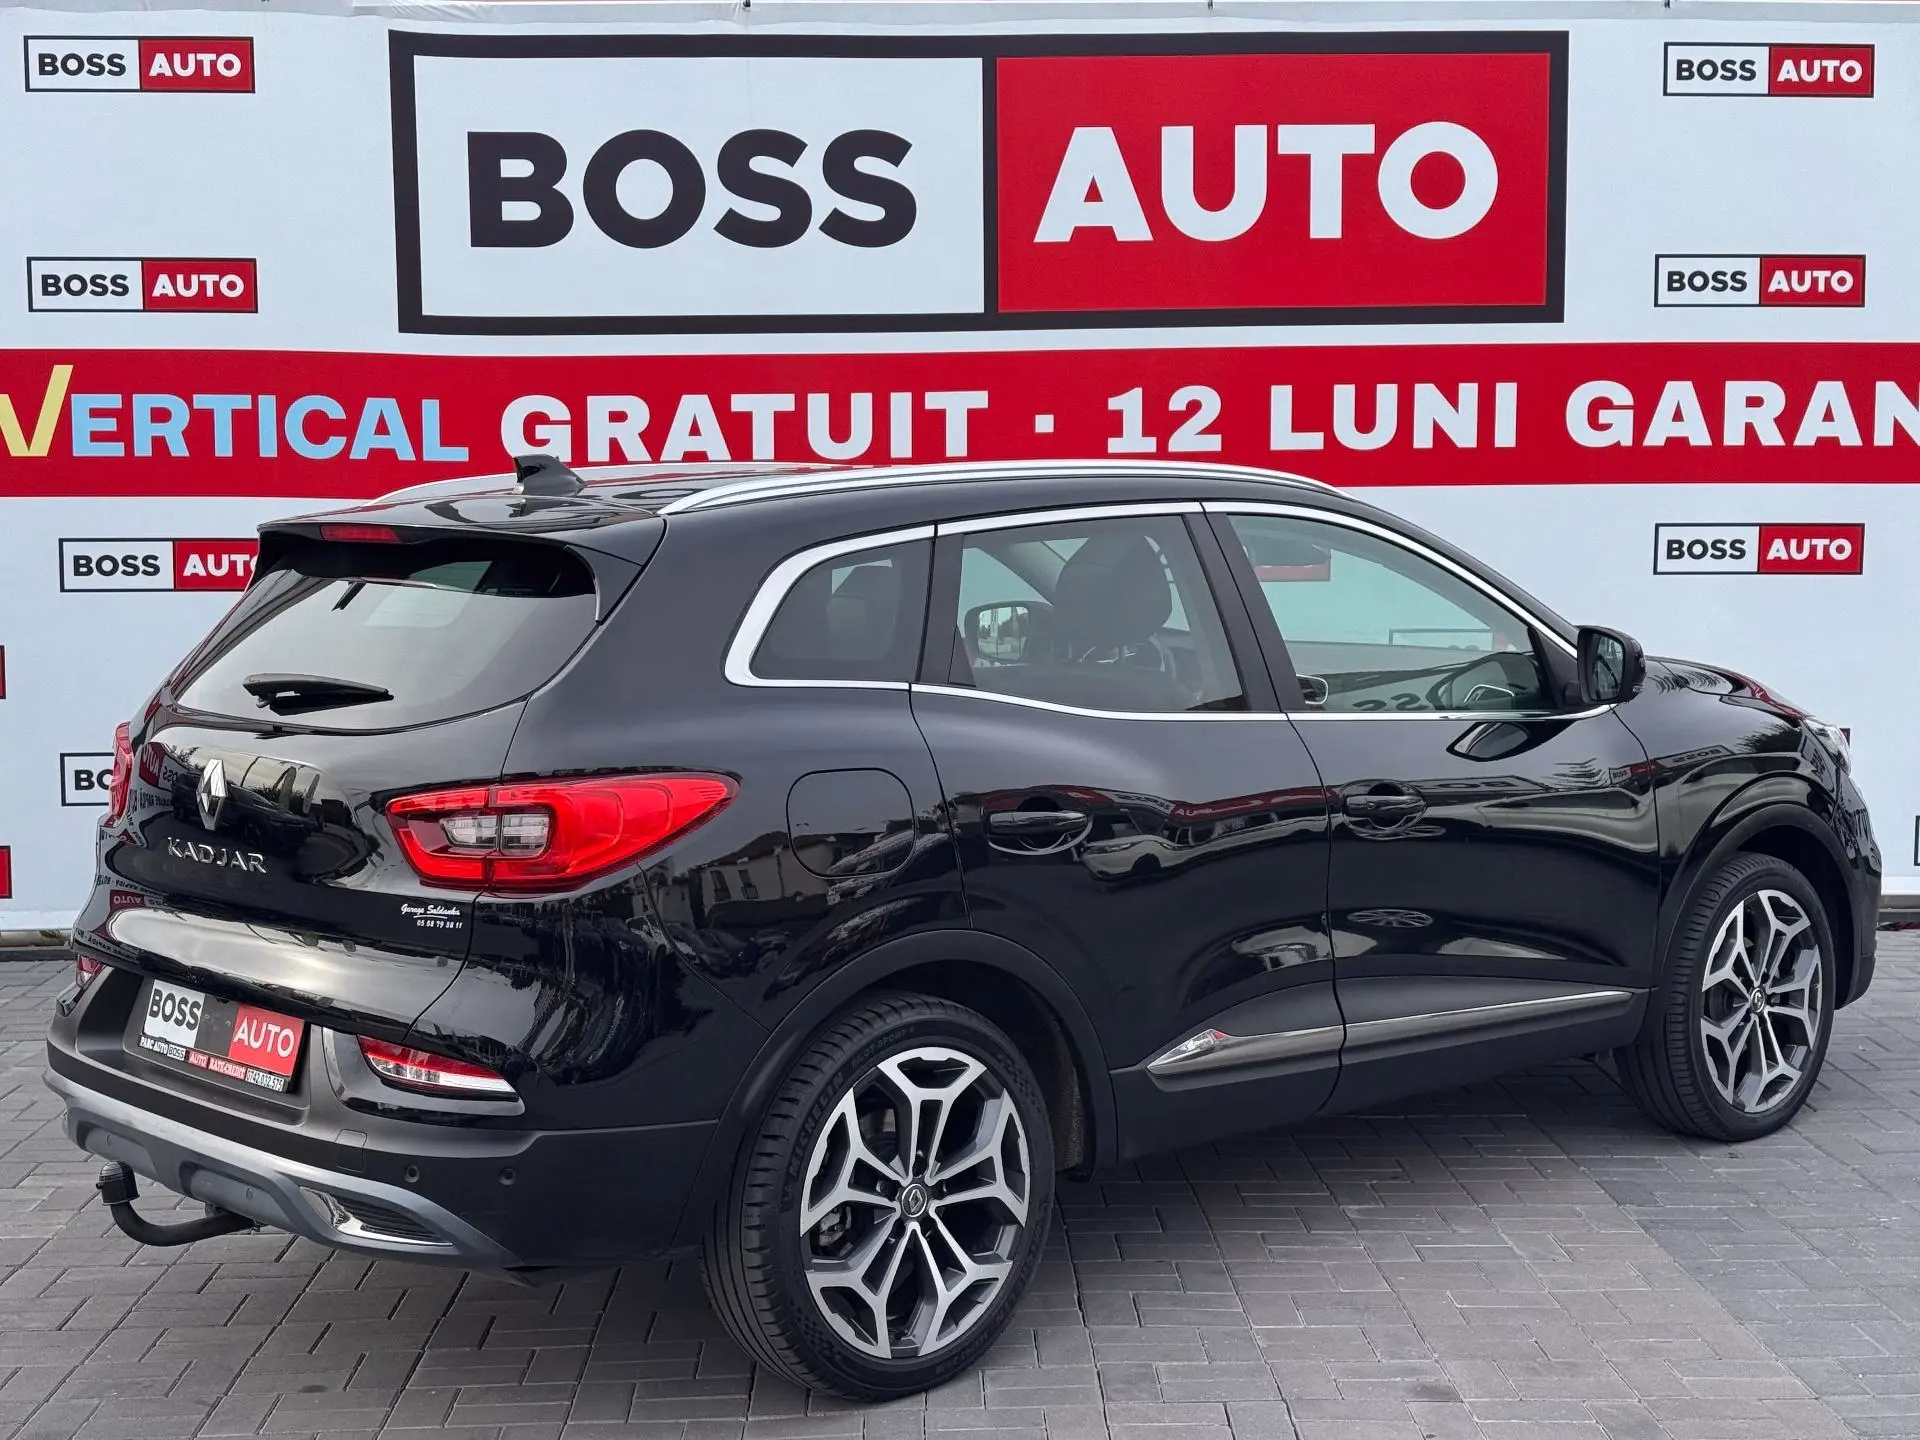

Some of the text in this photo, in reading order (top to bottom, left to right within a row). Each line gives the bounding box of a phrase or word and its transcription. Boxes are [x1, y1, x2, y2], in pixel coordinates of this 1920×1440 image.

[38, 53, 242, 78] BOSS AUTO
[1676, 59, 1863, 83] BOSS AUTO
[467, 121, 1499, 250] BOSS AUTO
[41, 273, 245, 298] BOSS AUTO
[1667, 269, 1854, 293] BOSS AUTO
[0, 364, 470, 462] VERTICAL
[500, 391, 989, 463] GRATUIT
[1106, 385, 1223, 456] 12
[1269, 382, 1518, 451] LUNI
[1666, 538, 1852, 561] BOSS AUTO
[73, 553, 258, 577] BOSS AUT
[167, 836, 267, 874] KADJAR
[400, 903, 425, 916] Garage
[149, 988, 295, 1058] BOSS AUTO
[140, 1036, 154, 1050] PARC
[153, 1041, 168, 1055] AUTO
[168, 1046, 186, 1060] BOSS
[189, 1051, 208, 1068] AUTO
